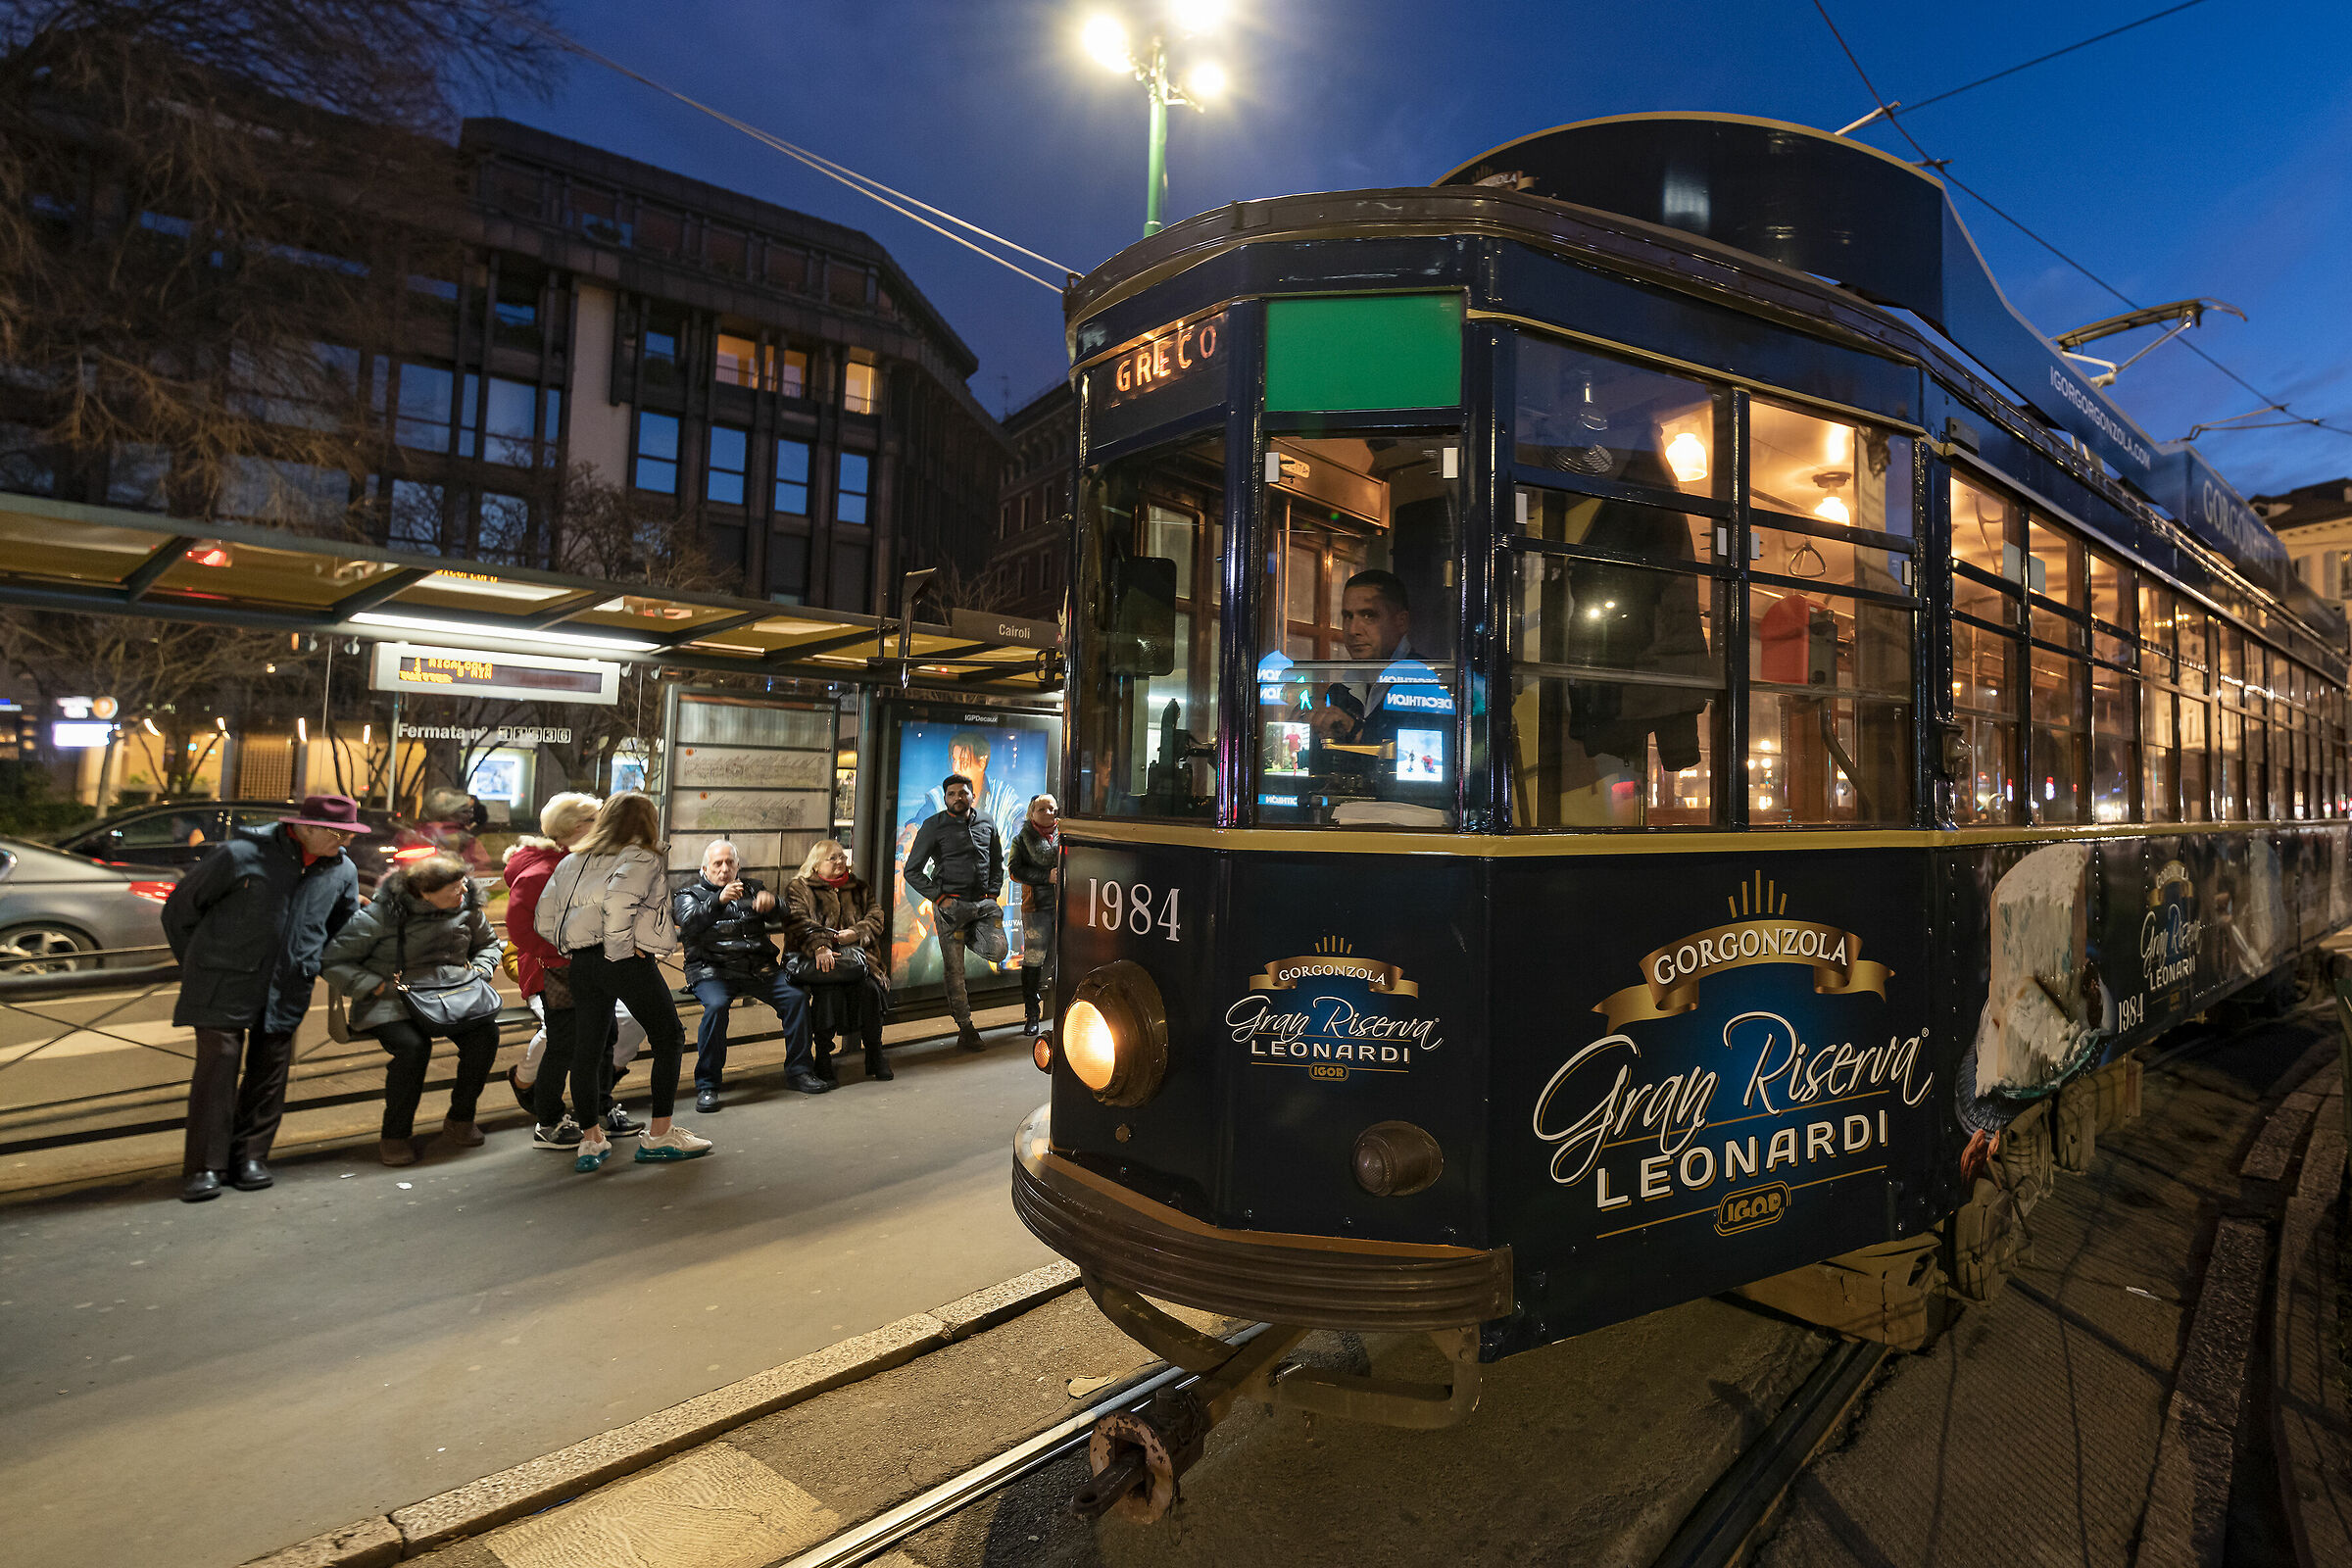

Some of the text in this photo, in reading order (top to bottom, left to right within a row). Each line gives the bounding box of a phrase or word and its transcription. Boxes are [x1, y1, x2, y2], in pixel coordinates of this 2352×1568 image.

[1116, 324, 1217, 392] GRECO
[2050, 366, 2151, 470] IGORGORGONZOLA.COM
[999, 623, 1031, 639] Cairoli
[398, 723, 466, 739] Fermata
[964, 714, 999, 723] IGPDecaux
[1087, 878, 1182, 943] 1984
[1279, 964, 1387, 986] GORGONZOLA
[1653, 928, 1849, 986] GORGONZOLA
[1225, 995, 1310, 1043] Gran
[2118, 992, 2144, 1034] 1984
[1250, 1040, 1410, 1063] LEONARDI
[1313, 1066, 1345, 1077] IGOR
[1533, 1034, 1720, 1187] Gran
[1596, 1109, 1889, 1213] LEONARDI
